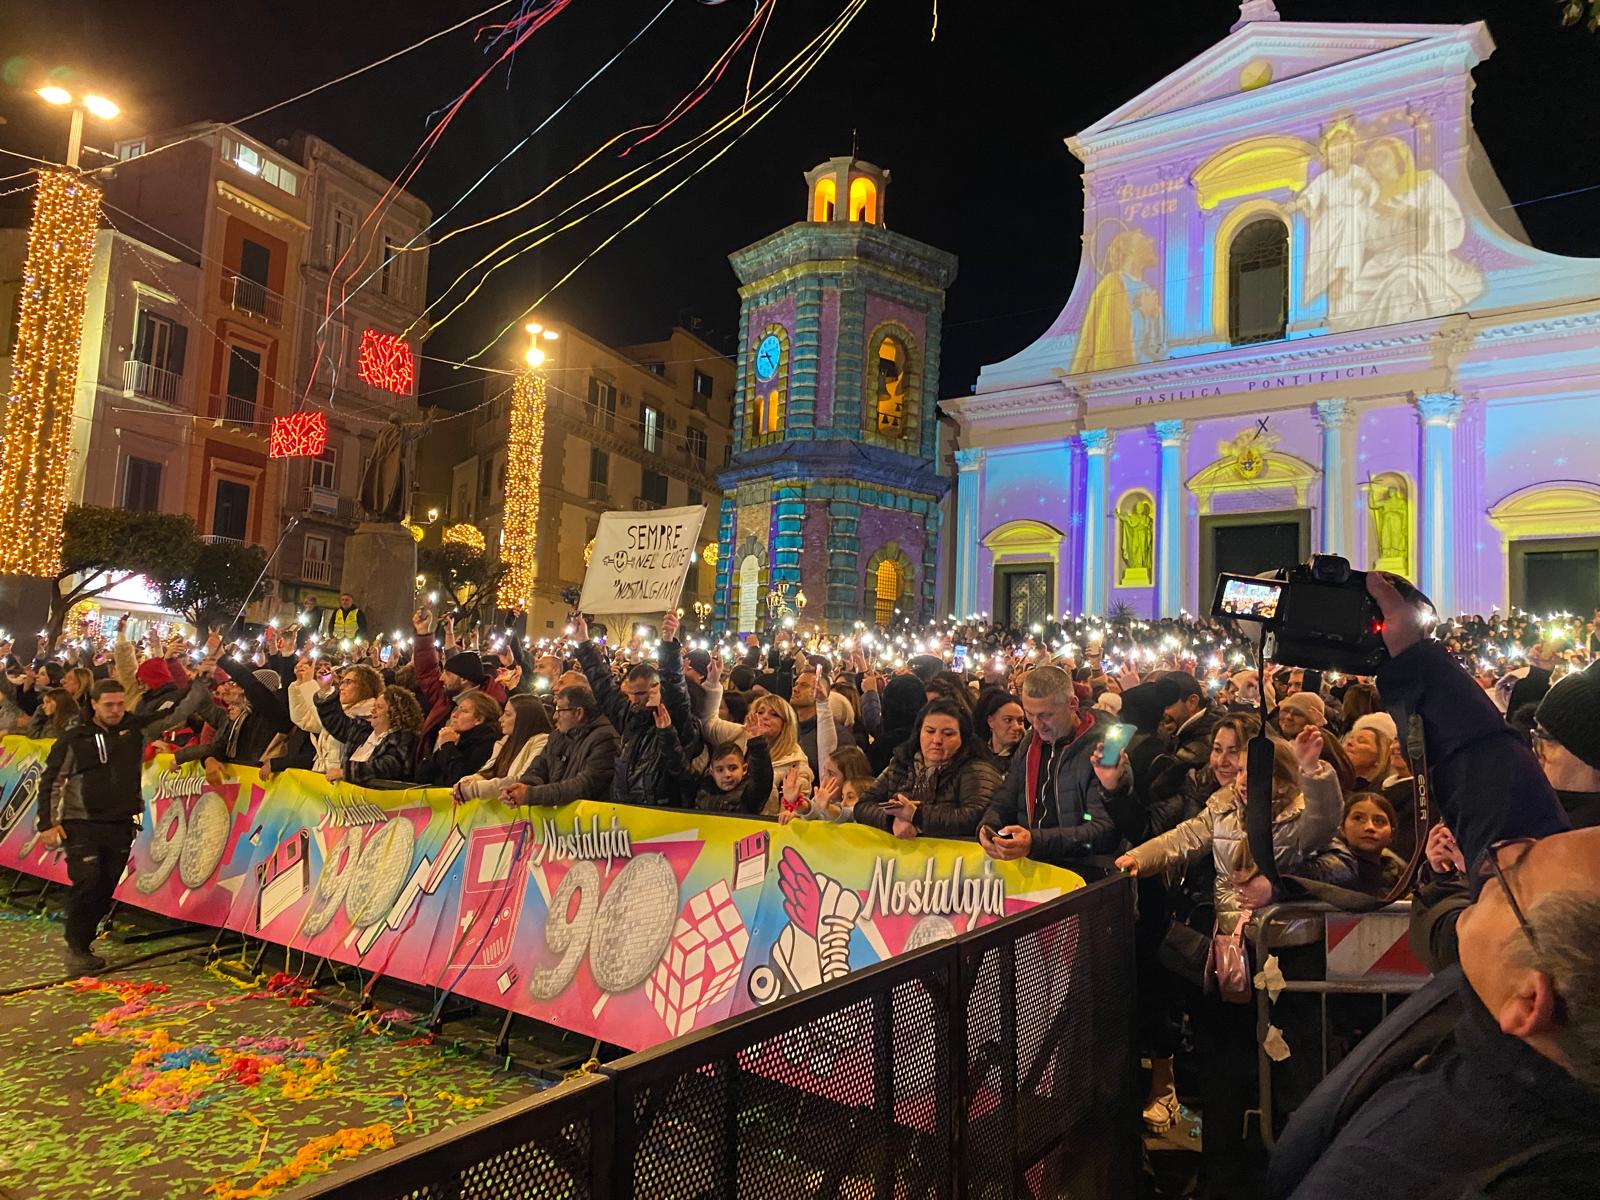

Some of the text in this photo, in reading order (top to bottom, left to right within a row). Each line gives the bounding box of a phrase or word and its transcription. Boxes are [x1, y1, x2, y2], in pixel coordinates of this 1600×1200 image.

[1135, 365, 1378, 406] BASILICA PONTIFICIA
[627, 524, 682, 550] SEMPRE
[635, 553, 655, 569] NEL
[1417, 774, 1427, 820] EOS R
[135, 791, 230, 895] 90
[534, 814, 632, 878] Nostalgia
[303, 816, 414, 937] 90
[860, 855, 1005, 932] Nostalgia
[530, 852, 679, 999] 90
